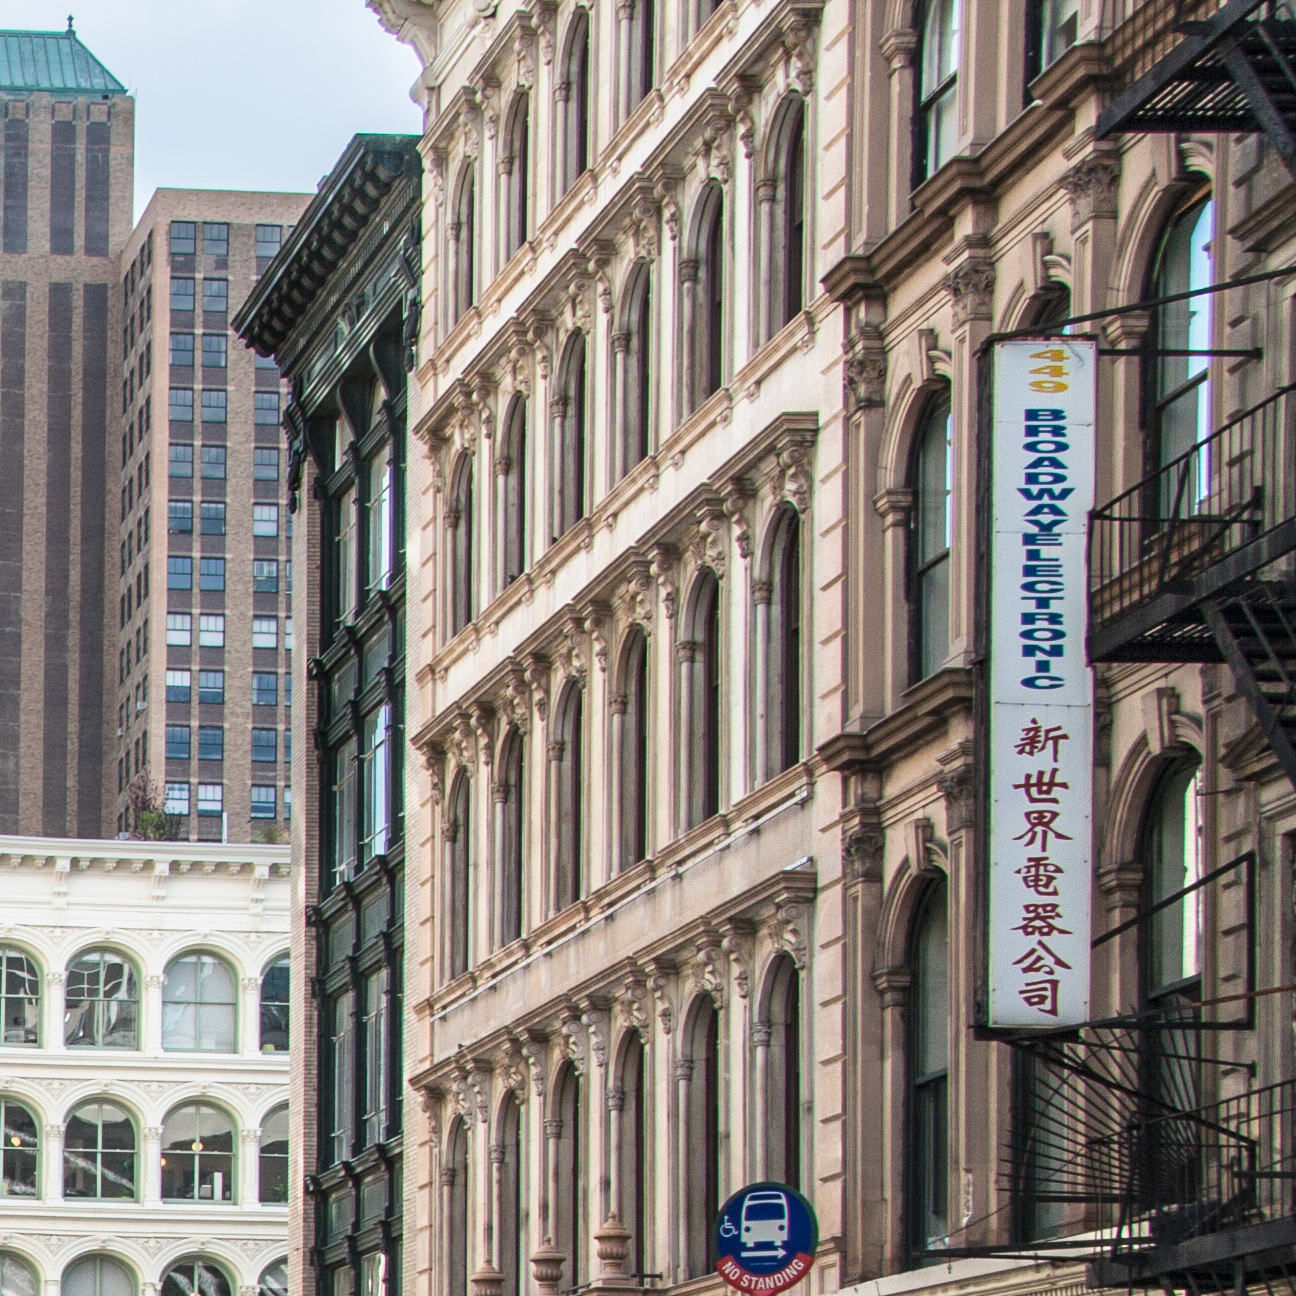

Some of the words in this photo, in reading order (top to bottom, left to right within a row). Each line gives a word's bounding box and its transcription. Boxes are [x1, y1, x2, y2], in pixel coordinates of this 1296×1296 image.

[1028, 348, 1071, 394] 449
[1009, 717, 1074, 1018] 新世界電器公司
[721, 1260, 741, 1281] NO
[740, 1258, 805, 1291] STANDING
